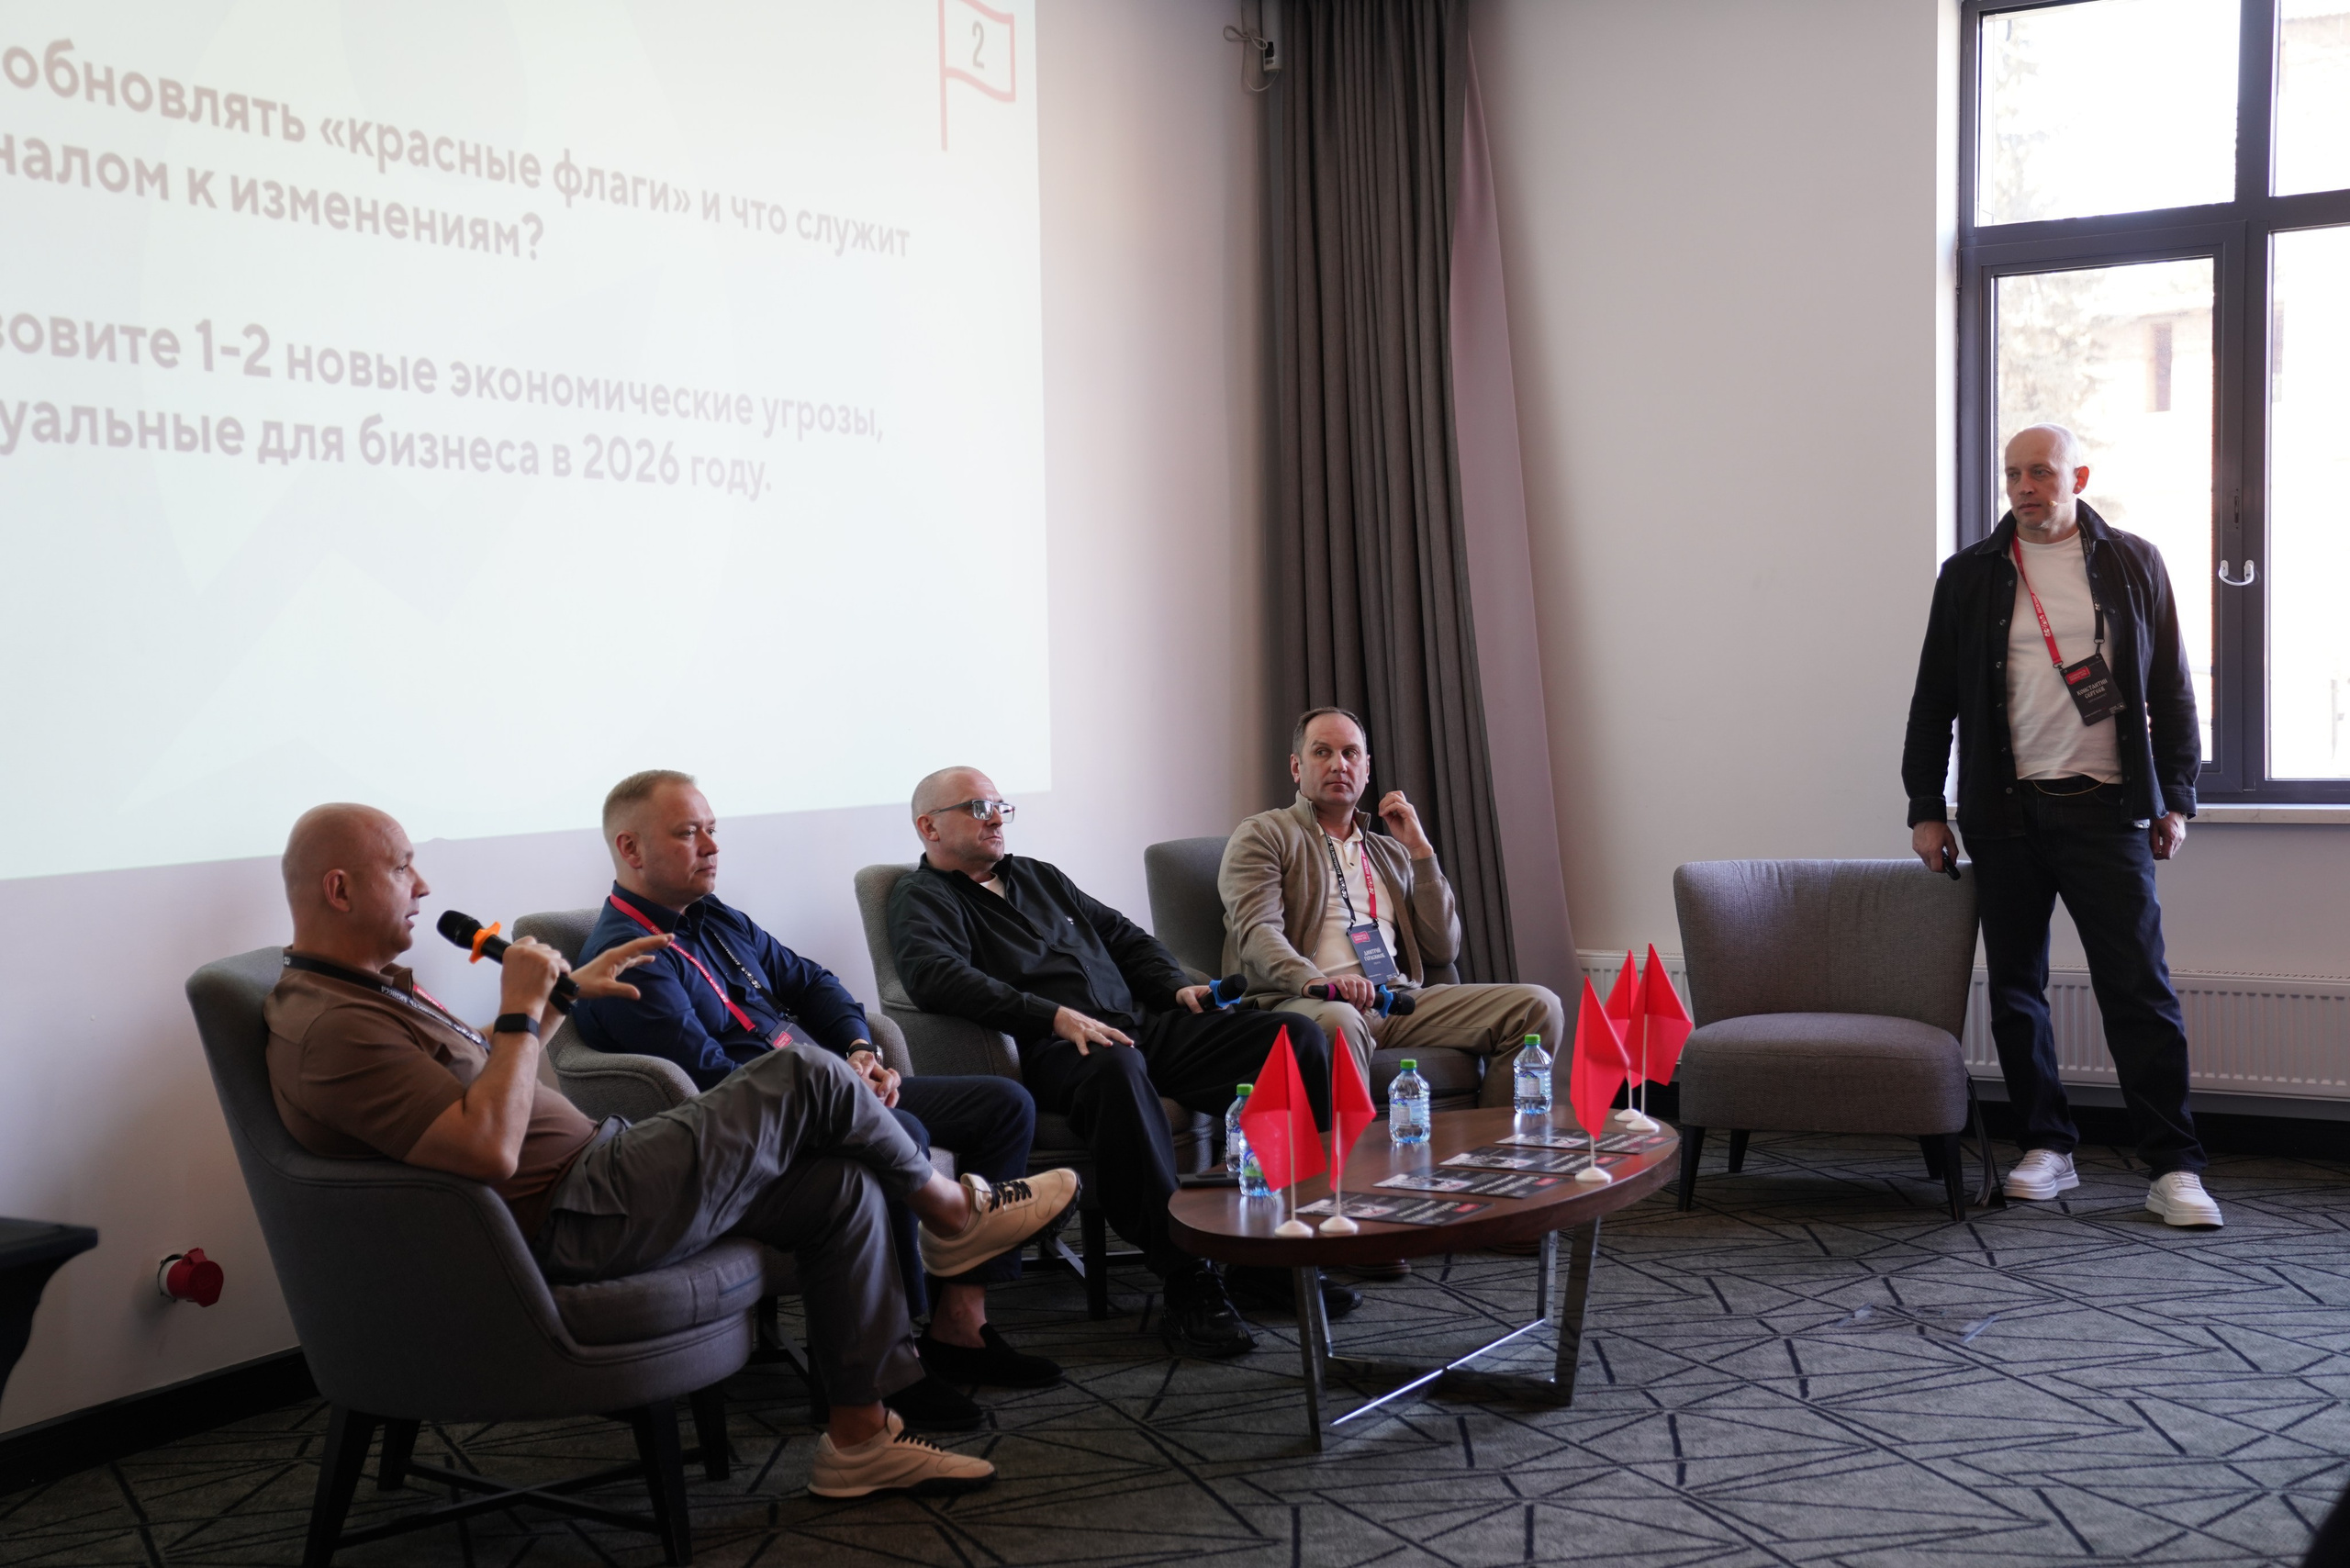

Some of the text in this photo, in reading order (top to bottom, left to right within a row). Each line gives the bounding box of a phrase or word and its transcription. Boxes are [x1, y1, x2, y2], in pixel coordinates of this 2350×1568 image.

[971, 20, 986, 70] 2
[1, 37, 911, 257] обновлять «красные флаги» и что служит
[186, 166, 218, 210] к
[230, 174, 544, 261] изменениям?
[0, 312, 182, 370] овите
[286, 343, 438, 395] новые
[450, 361, 754, 426] экономические
[761, 398, 884, 442] угрозы,
[0, 398, 772, 502] уальные для бизнеса в 2026 году.
